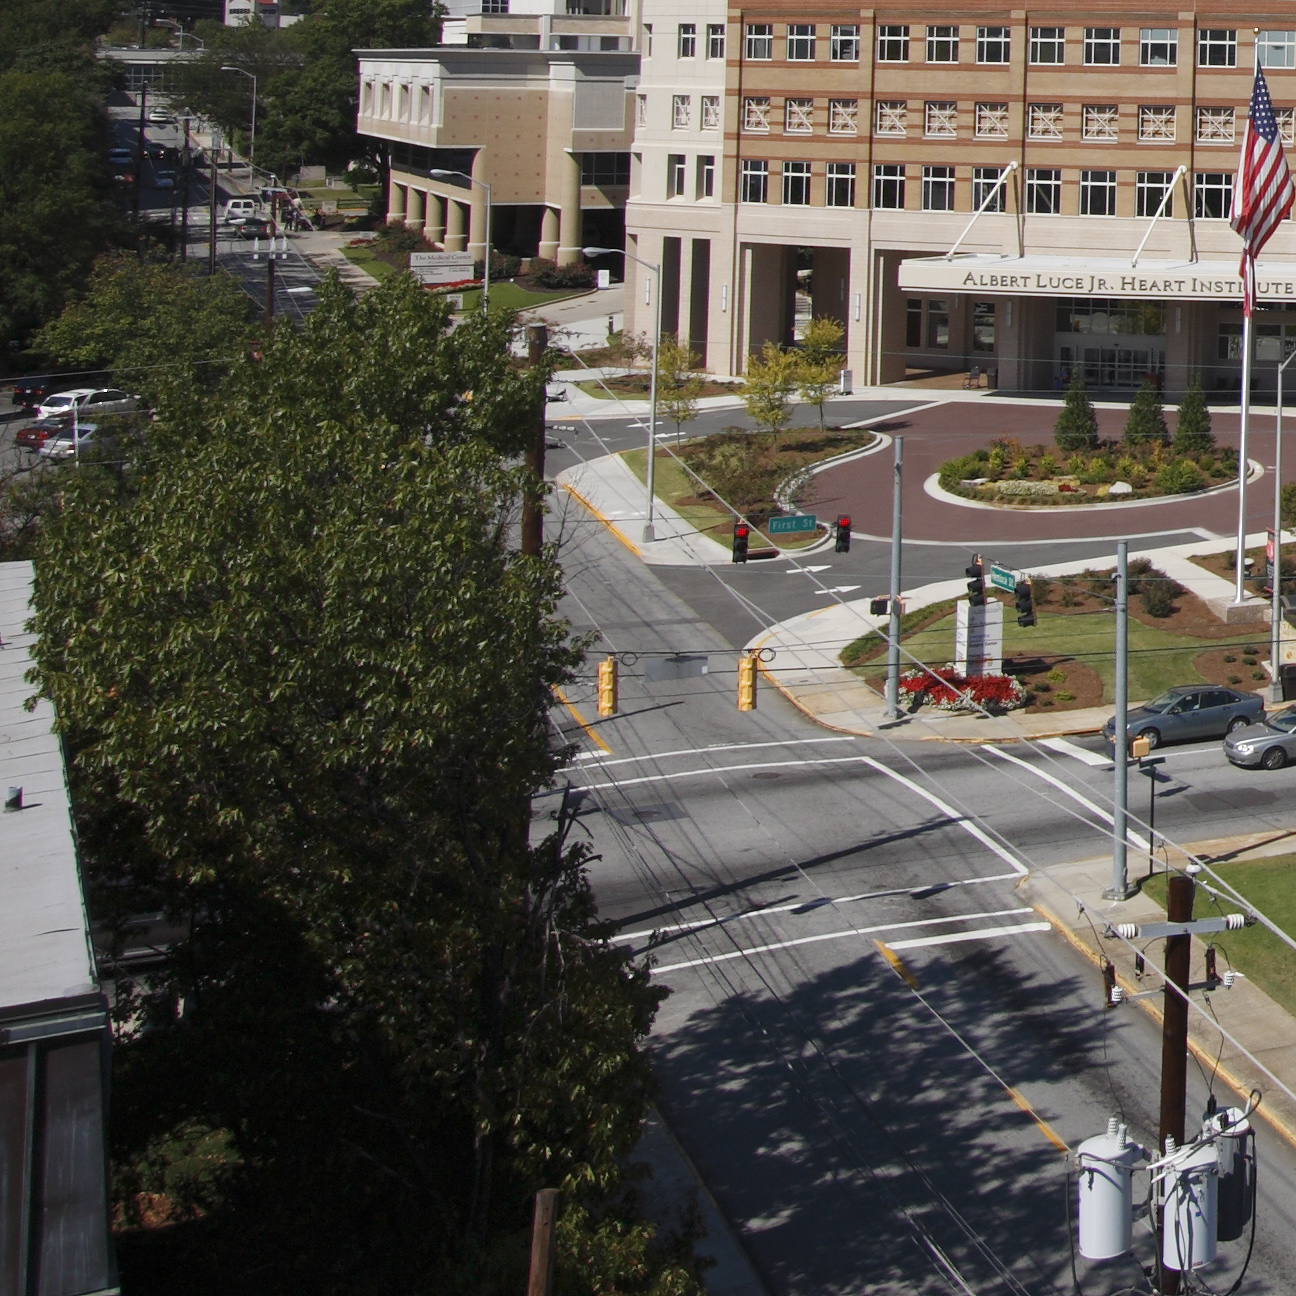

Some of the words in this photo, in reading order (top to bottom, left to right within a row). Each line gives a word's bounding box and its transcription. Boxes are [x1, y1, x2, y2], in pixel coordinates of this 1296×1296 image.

[963, 271, 1031, 288] ALBERT
[1035, 274, 1084, 290] LUCE
[1120, 276, 1186, 292] HEART
[1191, 277, 1294, 295] INSTIUTE
[772, 520, 797, 530] First
[802, 518, 813, 528] St
